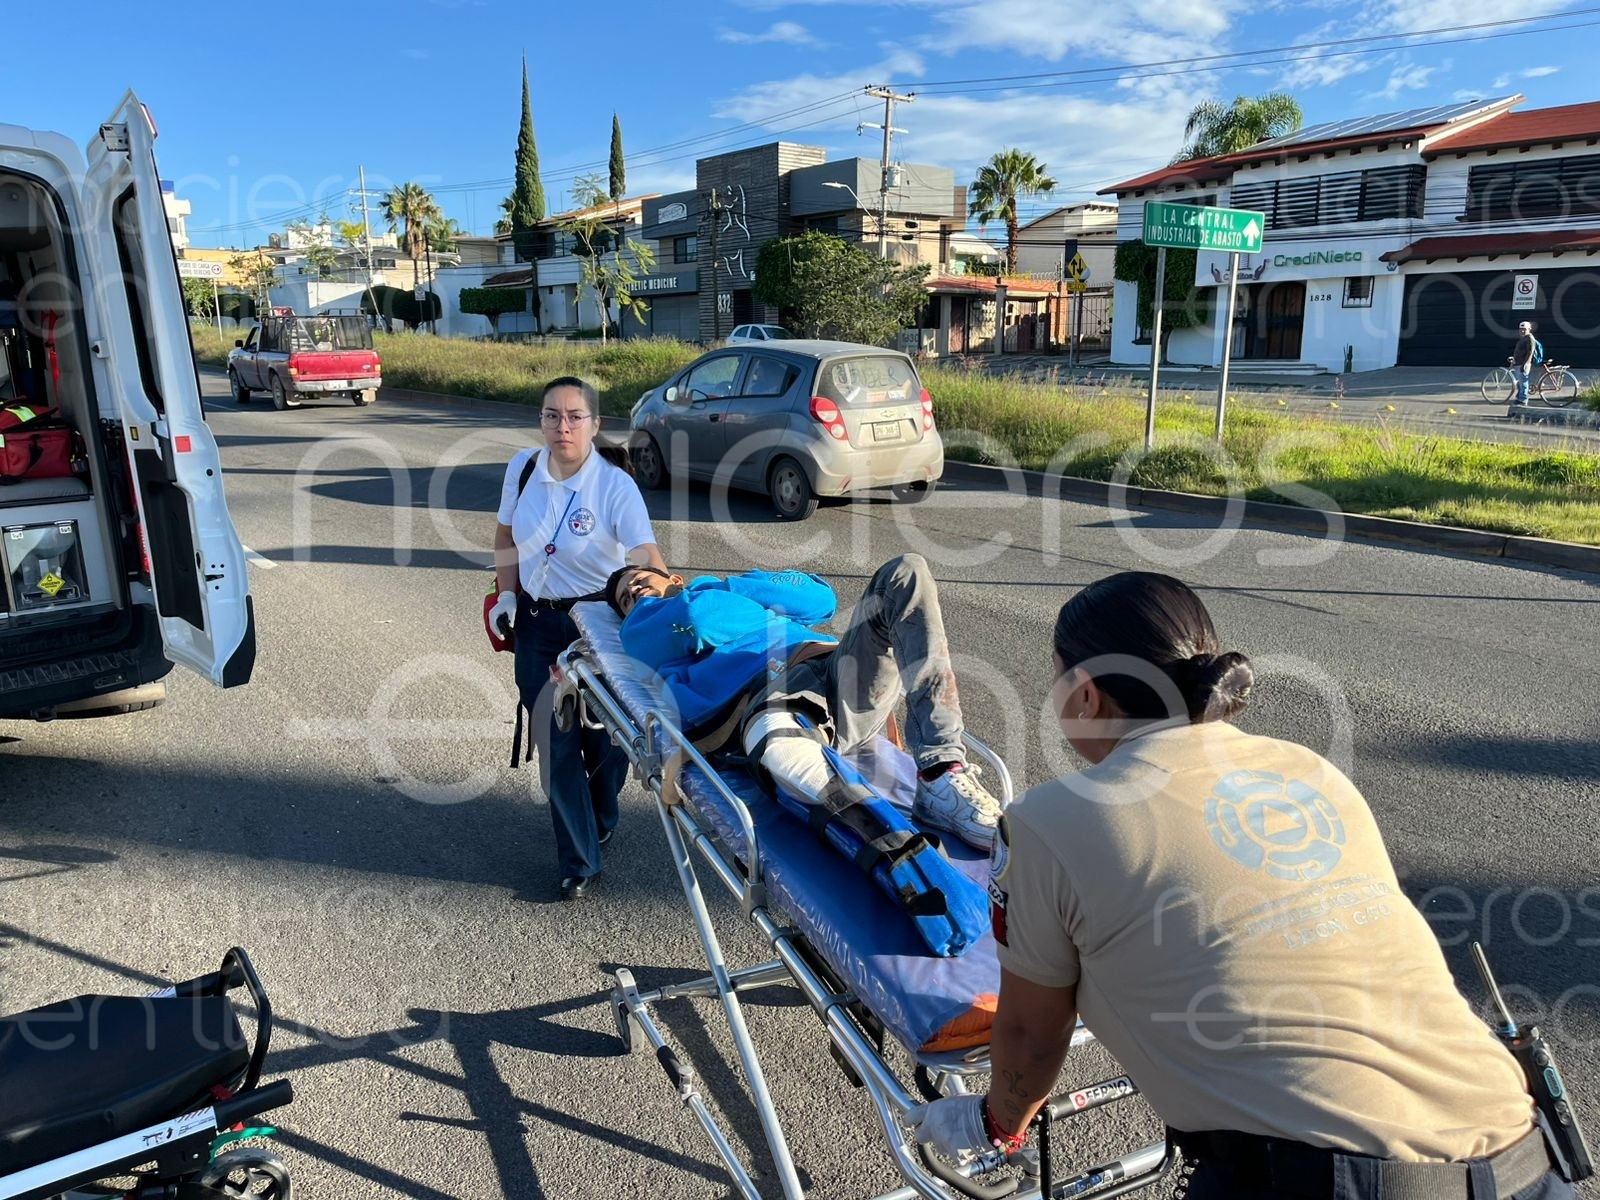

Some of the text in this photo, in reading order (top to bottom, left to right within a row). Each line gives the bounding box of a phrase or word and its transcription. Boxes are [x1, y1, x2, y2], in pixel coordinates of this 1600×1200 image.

[1163, 208, 1234, 229] LA CENTRAL
[1148, 225, 1242, 246] INDUSTRIAL DE ABASTO
[1274, 251, 1363, 268] CrediNieto
[649, 277, 678, 290] MEDICINE
[1310, 294, 1332, 302] 1828
